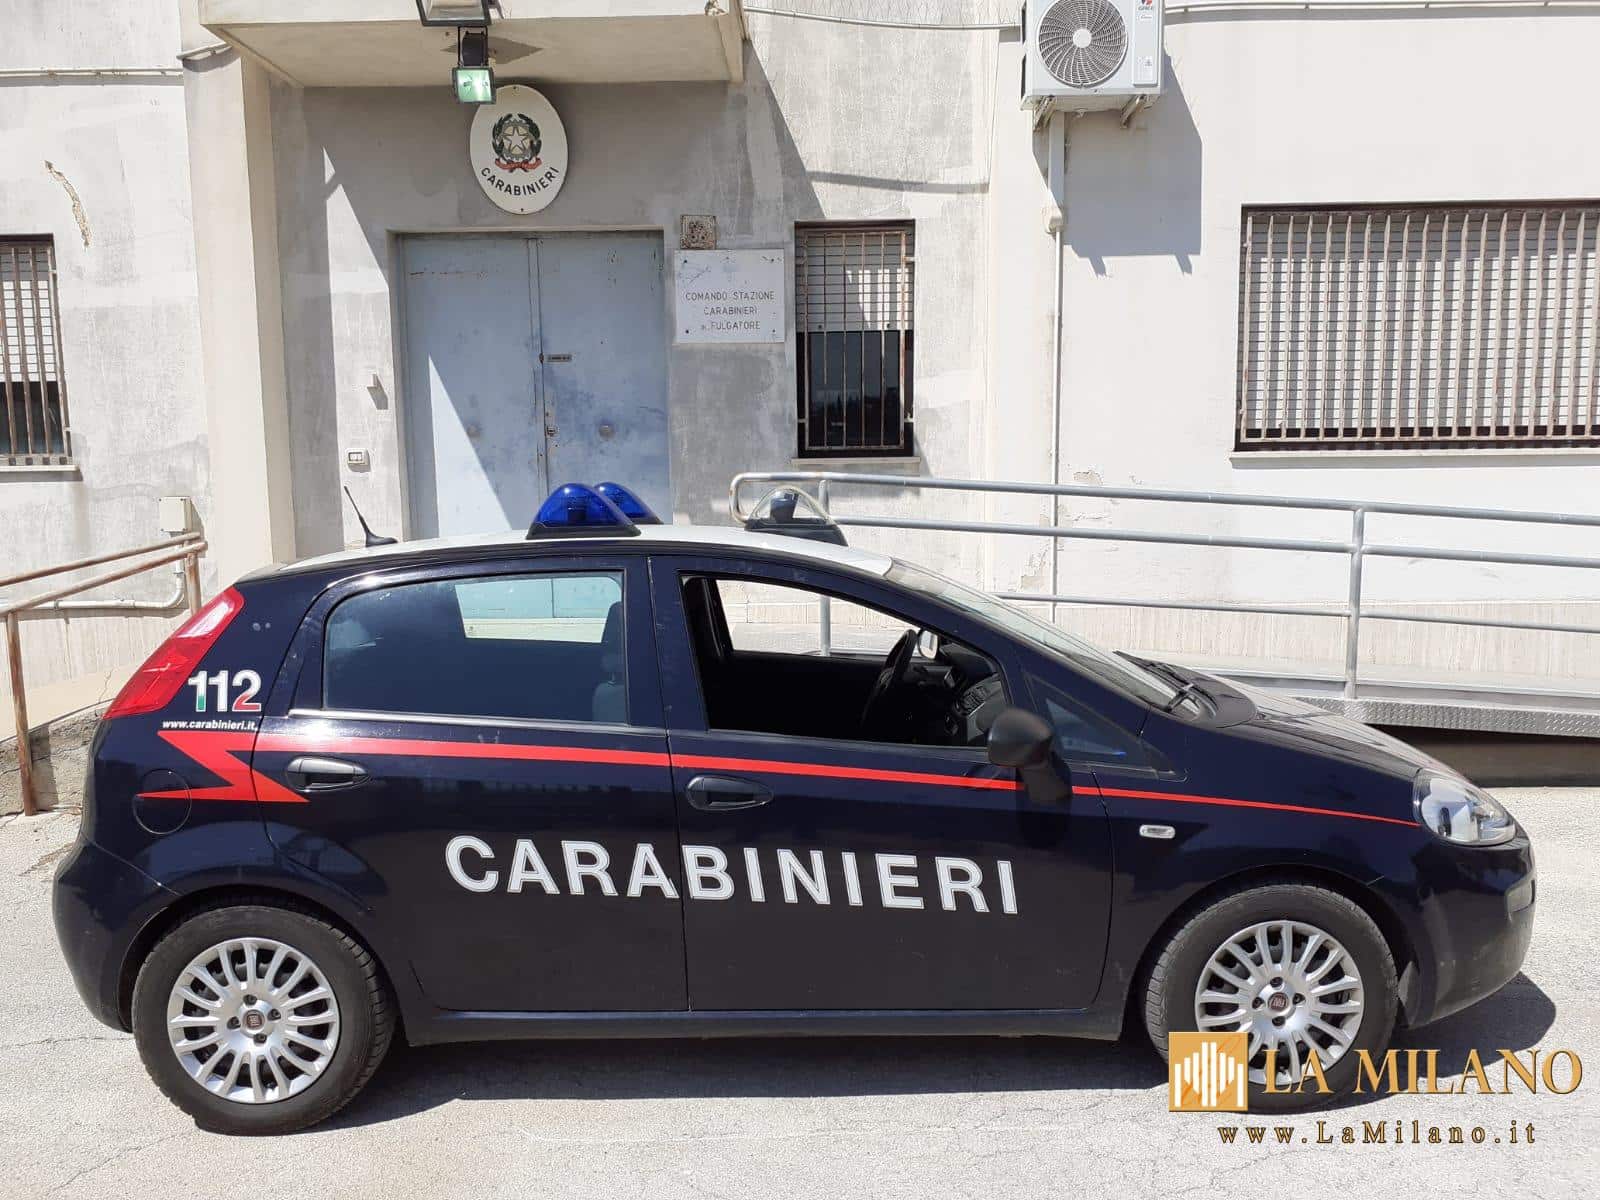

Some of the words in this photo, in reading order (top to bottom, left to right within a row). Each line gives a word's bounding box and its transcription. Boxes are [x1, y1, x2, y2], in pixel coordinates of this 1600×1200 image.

[481, 166, 560, 196] CARABINIERI
[685, 292, 728, 301] COMANDO
[732, 291, 775, 301] STAZIONE
[703, 306, 758, 316] CARABINIERI
[711, 321, 761, 330] FULGATORE
[188, 669, 262, 712] 112
[162, 720, 256, 731] www.carabinieri.it
[445, 835, 1018, 914] CARABINIERI
